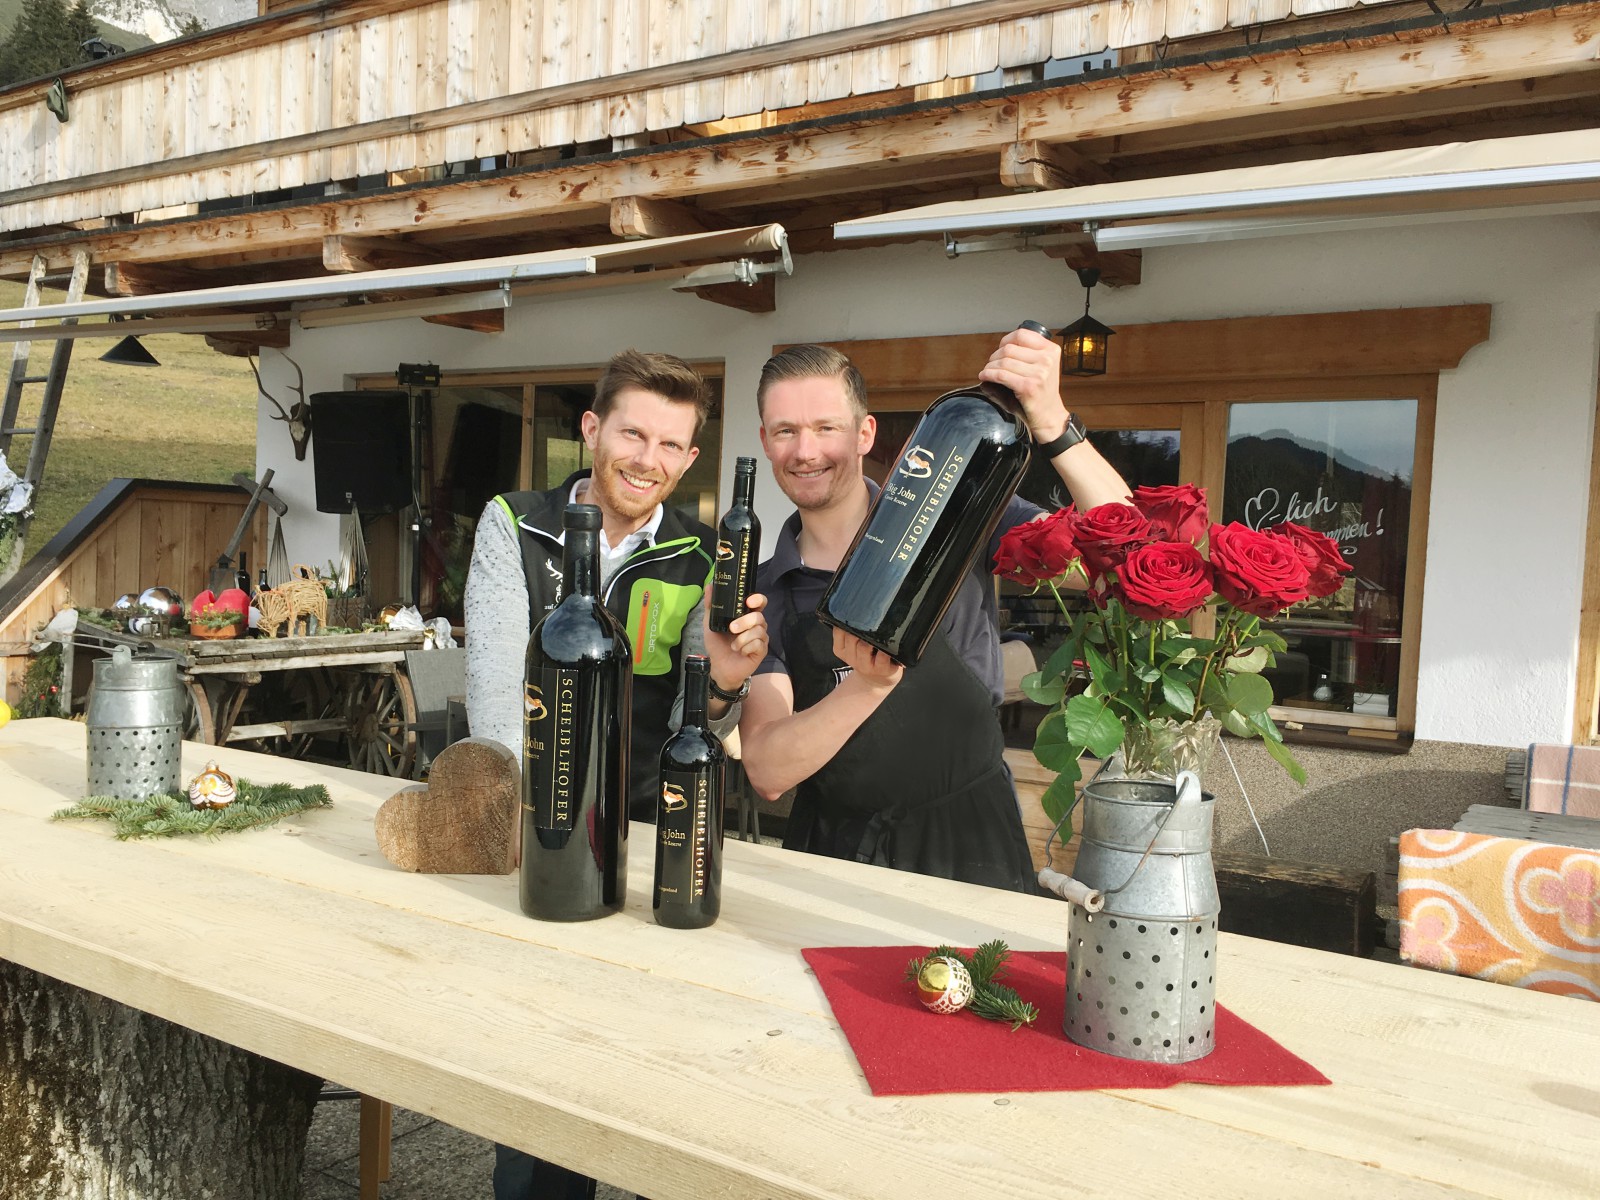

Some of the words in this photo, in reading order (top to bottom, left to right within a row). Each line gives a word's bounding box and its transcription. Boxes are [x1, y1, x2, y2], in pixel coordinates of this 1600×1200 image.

[886, 482, 898, 496] Big
[897, 486, 917, 502] John
[898, 454, 964, 561] SCHEIBLHOFER
[718, 571, 732, 580] John
[648, 602, 660, 653] ORTOVOX
[527, 736, 545, 751] John
[556, 678, 573, 821] SCHEIBLHOFER
[666, 828, 686, 840] John
[694, 779, 708, 897] SCHEIBLHOFER
